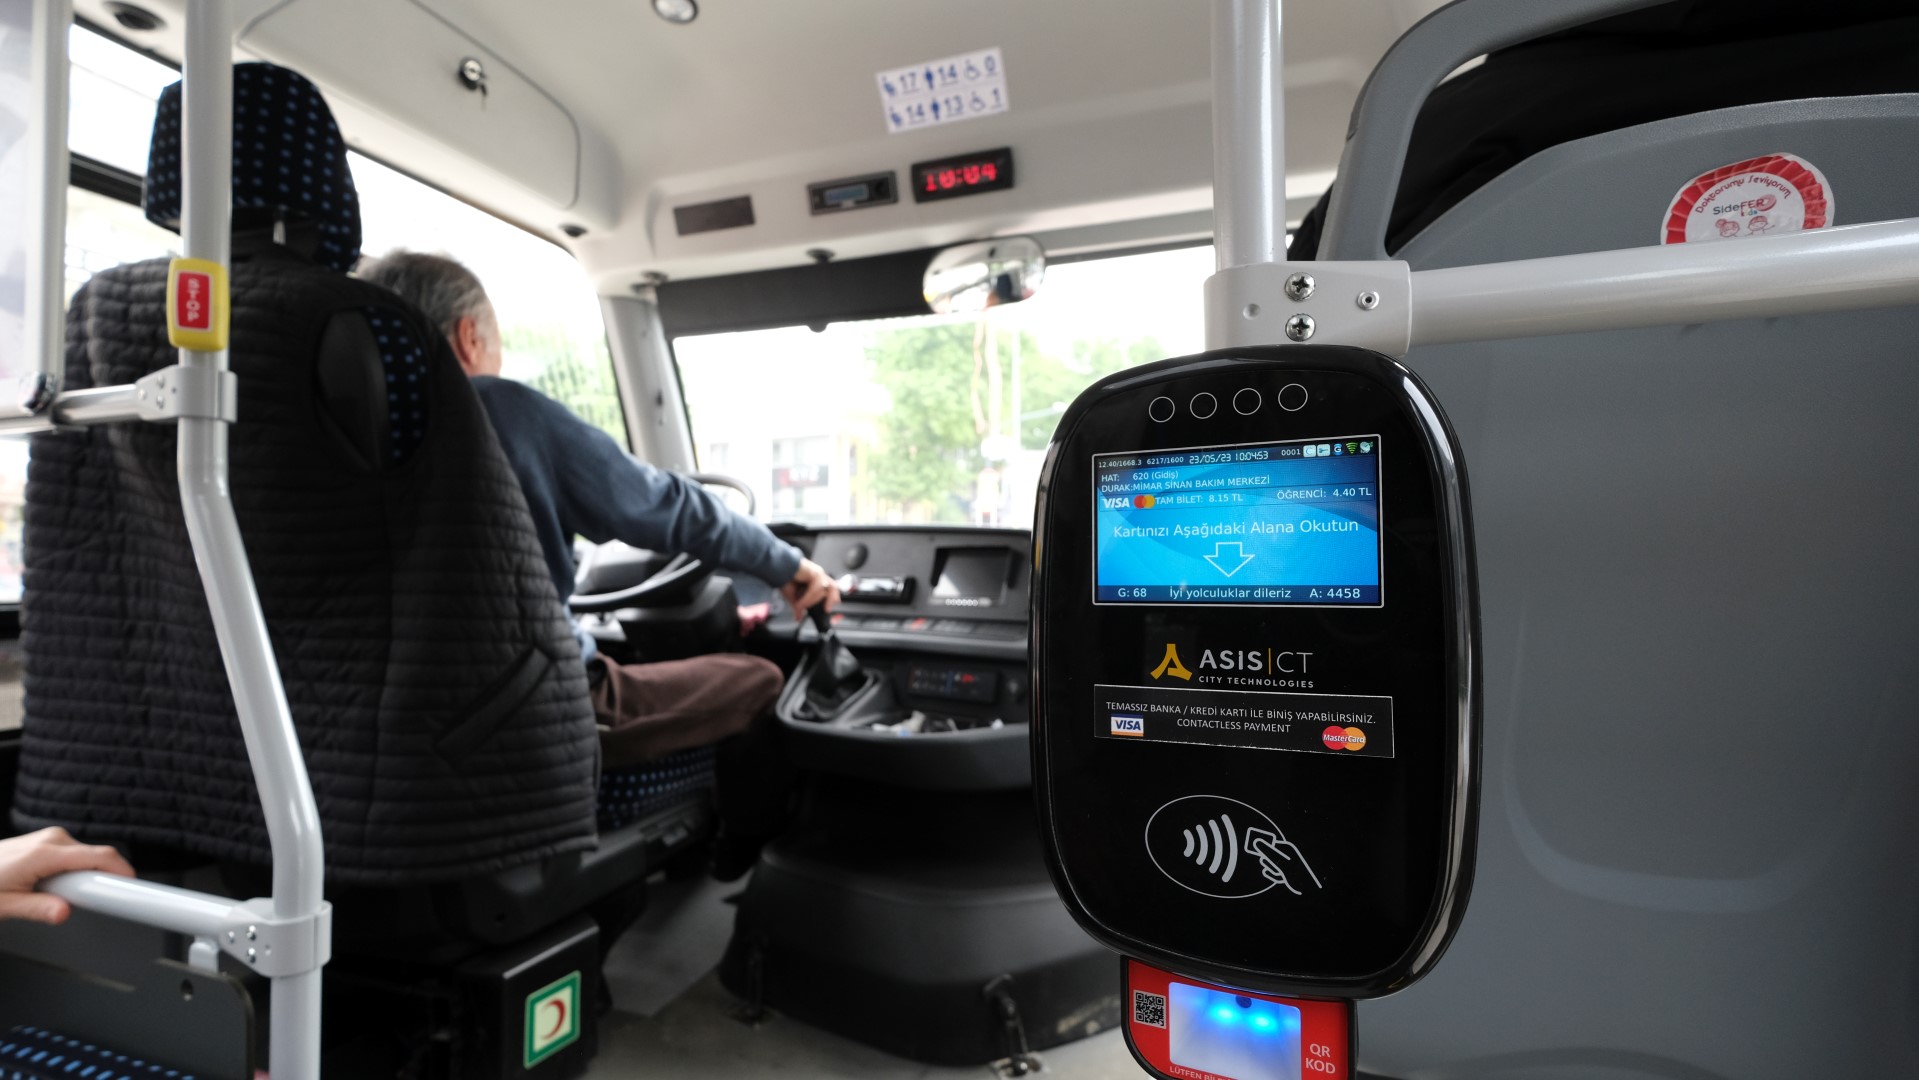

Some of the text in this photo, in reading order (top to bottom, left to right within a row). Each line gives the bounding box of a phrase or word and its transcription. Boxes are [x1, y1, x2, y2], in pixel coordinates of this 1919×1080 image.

[900, 55, 996, 91] 17 14 0
[906, 102, 925, 121] 14
[944, 95, 964, 116] 13
[925, 162, 998, 192] 10:04
[1695, 177, 1745, 213] Doktorumu
[186, 277, 201, 322] STOP
[1146, 456, 1184, 465] 6217/1600
[1189, 453, 1232, 465] 23/05/23
[1235, 451, 1269, 461] 10:04:53
[1281, 448, 1301, 456] 0001
[1101, 470, 1179, 482] HAT: 620 (Gidiş)
[1165, 479, 1193, 489] SİNAN
[1195, 478, 1225, 487] BAKIM
[1227, 475, 1271, 486] MERKEZİ
[1155, 493, 1244, 505] TAM BİLET: 8.15 TL
[1276, 487, 1373, 500] ÖĞRENCİ: 4.40 TL
[1103, 498, 1130, 508] VISA
[1113, 519, 1359, 538] Kartınızı Aşağıdaki Alana Okutun
[1117, 588, 1147, 598] G: 68
[1169, 585, 1292, 600] İyi yolculuklar dileriz
[1309, 588, 1361, 599] A: 4458
[1198, 676, 1314, 688] CITY TECHNOLOGIES
[1106, 701, 1148, 712] TEMASSIZ
[1150, 705, 1181, 714] BANKA
[1190, 705, 1217, 716] KREDİ
[1220, 708, 1247, 717] KARTI
[1250, 707, 1264, 718] İLE
[1266, 709, 1293, 721] BİNİŞ
[1115, 720, 1141, 730] VISA
[1177, 718, 1291, 733] CONTACTLESS PAYMENT
[1323, 734, 1366, 743] MasterCard
[1309, 1043, 1331, 1057] QR
[1169, 1066, 1202, 1079] LÜTFEN
[1305, 1058, 1336, 1074] KOD
